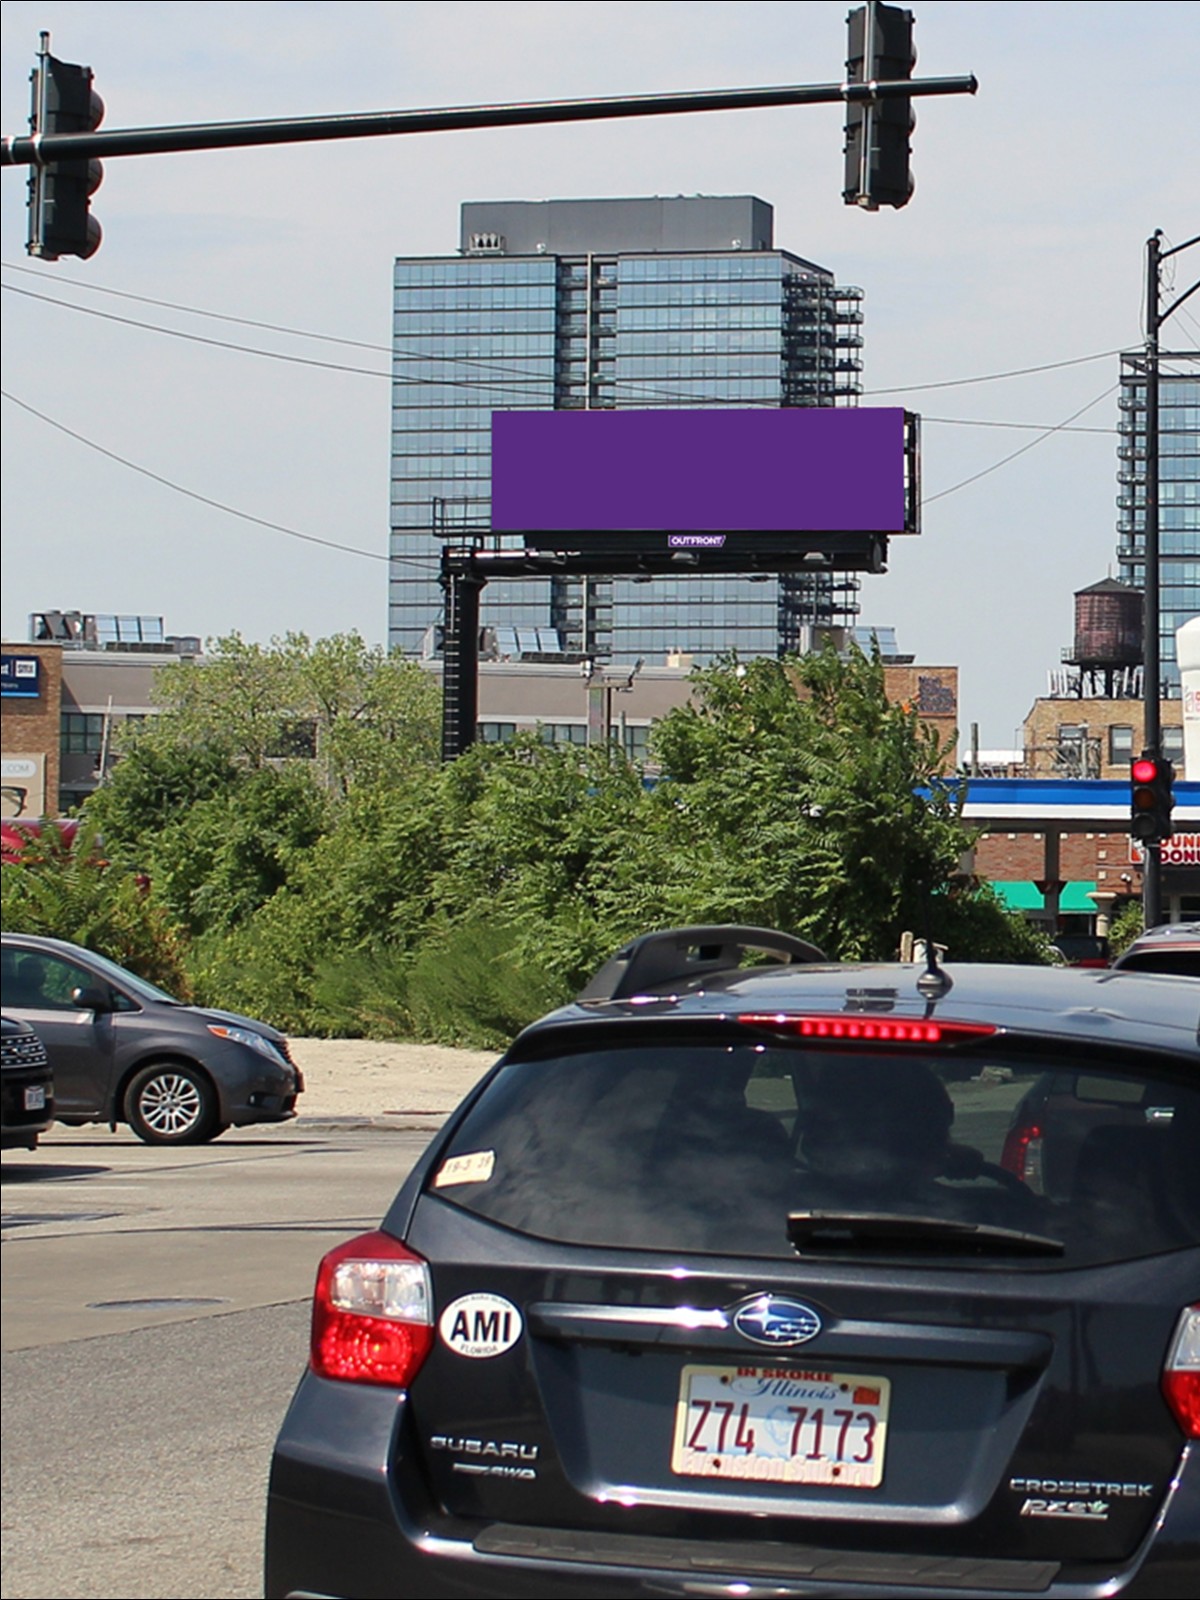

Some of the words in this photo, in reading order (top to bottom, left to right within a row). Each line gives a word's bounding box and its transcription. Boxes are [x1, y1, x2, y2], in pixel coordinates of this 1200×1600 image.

[671, 536, 723, 545] OUTFRONT
[450, 1310, 512, 1342] AMI
[460, 1344, 498, 1355] FLORIDA
[737, 1367, 756, 1377] IN
[763, 1368, 833, 1382] SKOKIE
[744, 1377, 839, 1401] Illinois
[688, 1400, 754, 1454] Z74
[788, 1406, 877, 1463] 7173
[431, 1436, 538, 1460] SUBARU
[1010, 1478, 1153, 1497] CROSSTREK
